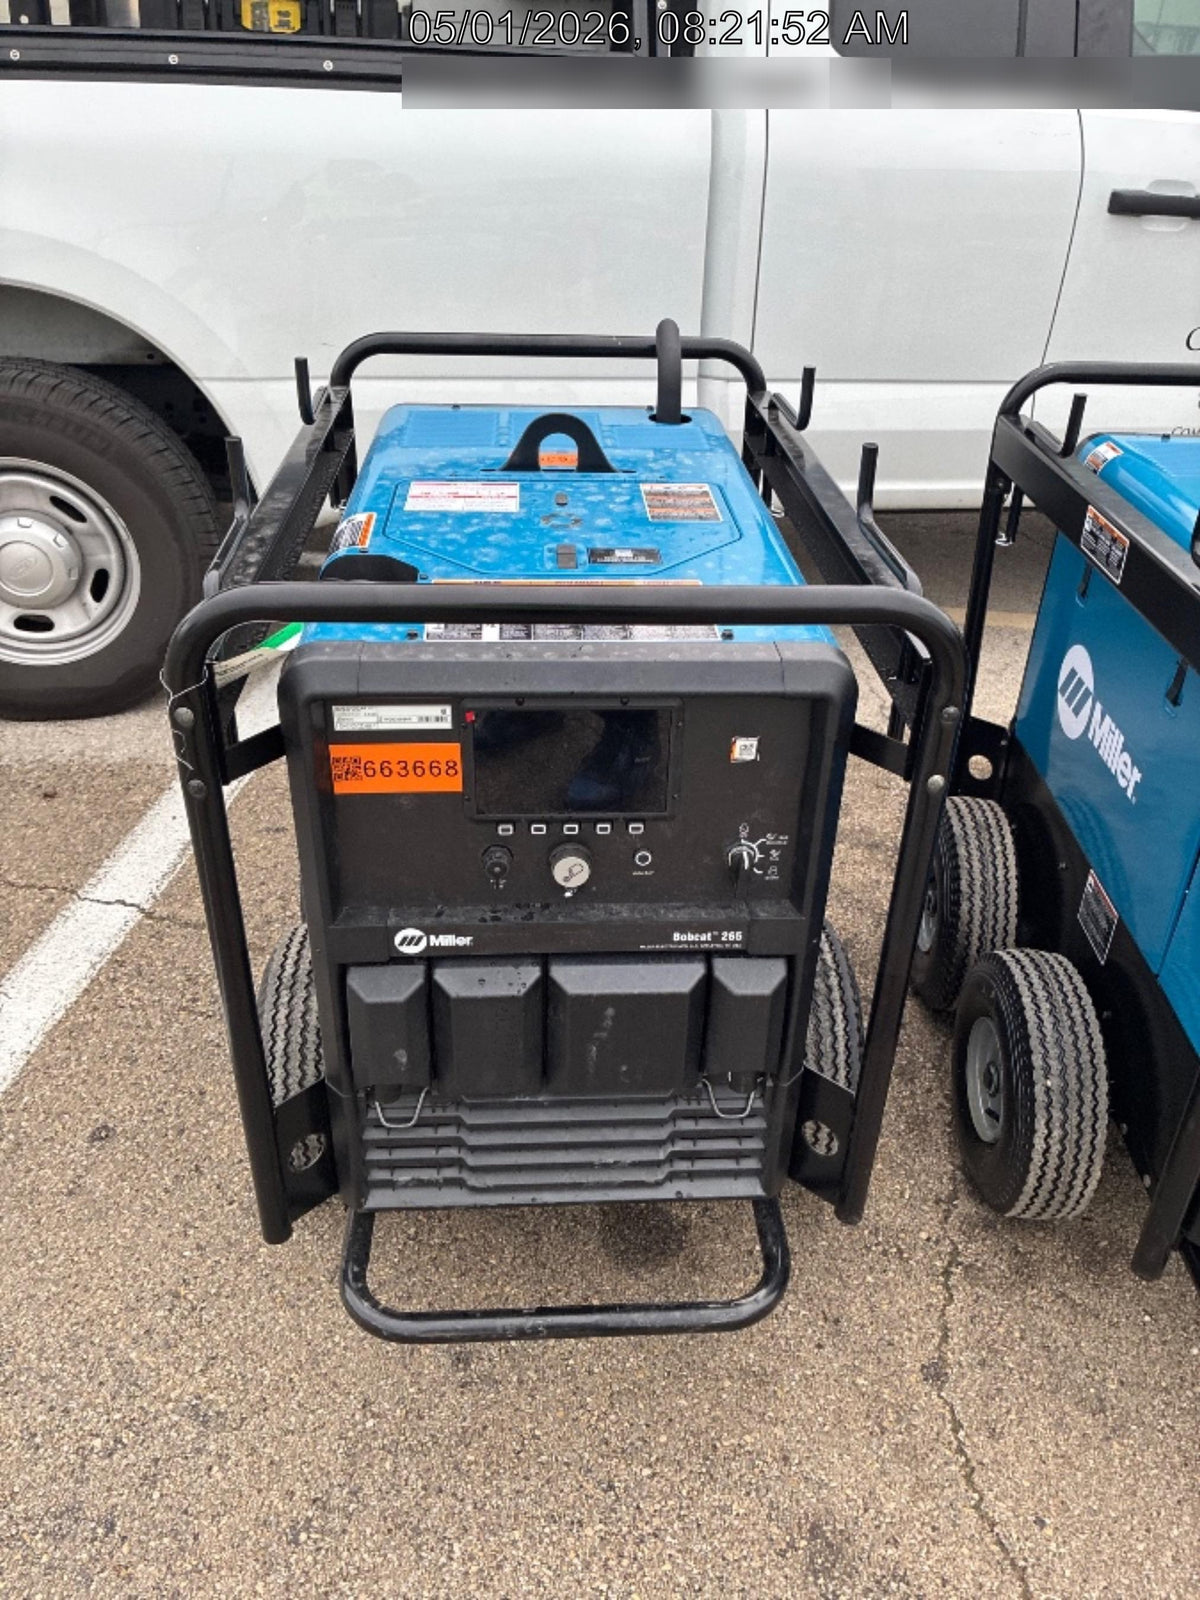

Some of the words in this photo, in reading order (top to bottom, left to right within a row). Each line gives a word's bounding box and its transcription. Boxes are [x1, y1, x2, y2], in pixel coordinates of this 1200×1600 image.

[1088, 701, 1142, 801] Miller
[363, 760, 459, 778] 663668
[429, 934, 473, 947] Miller
